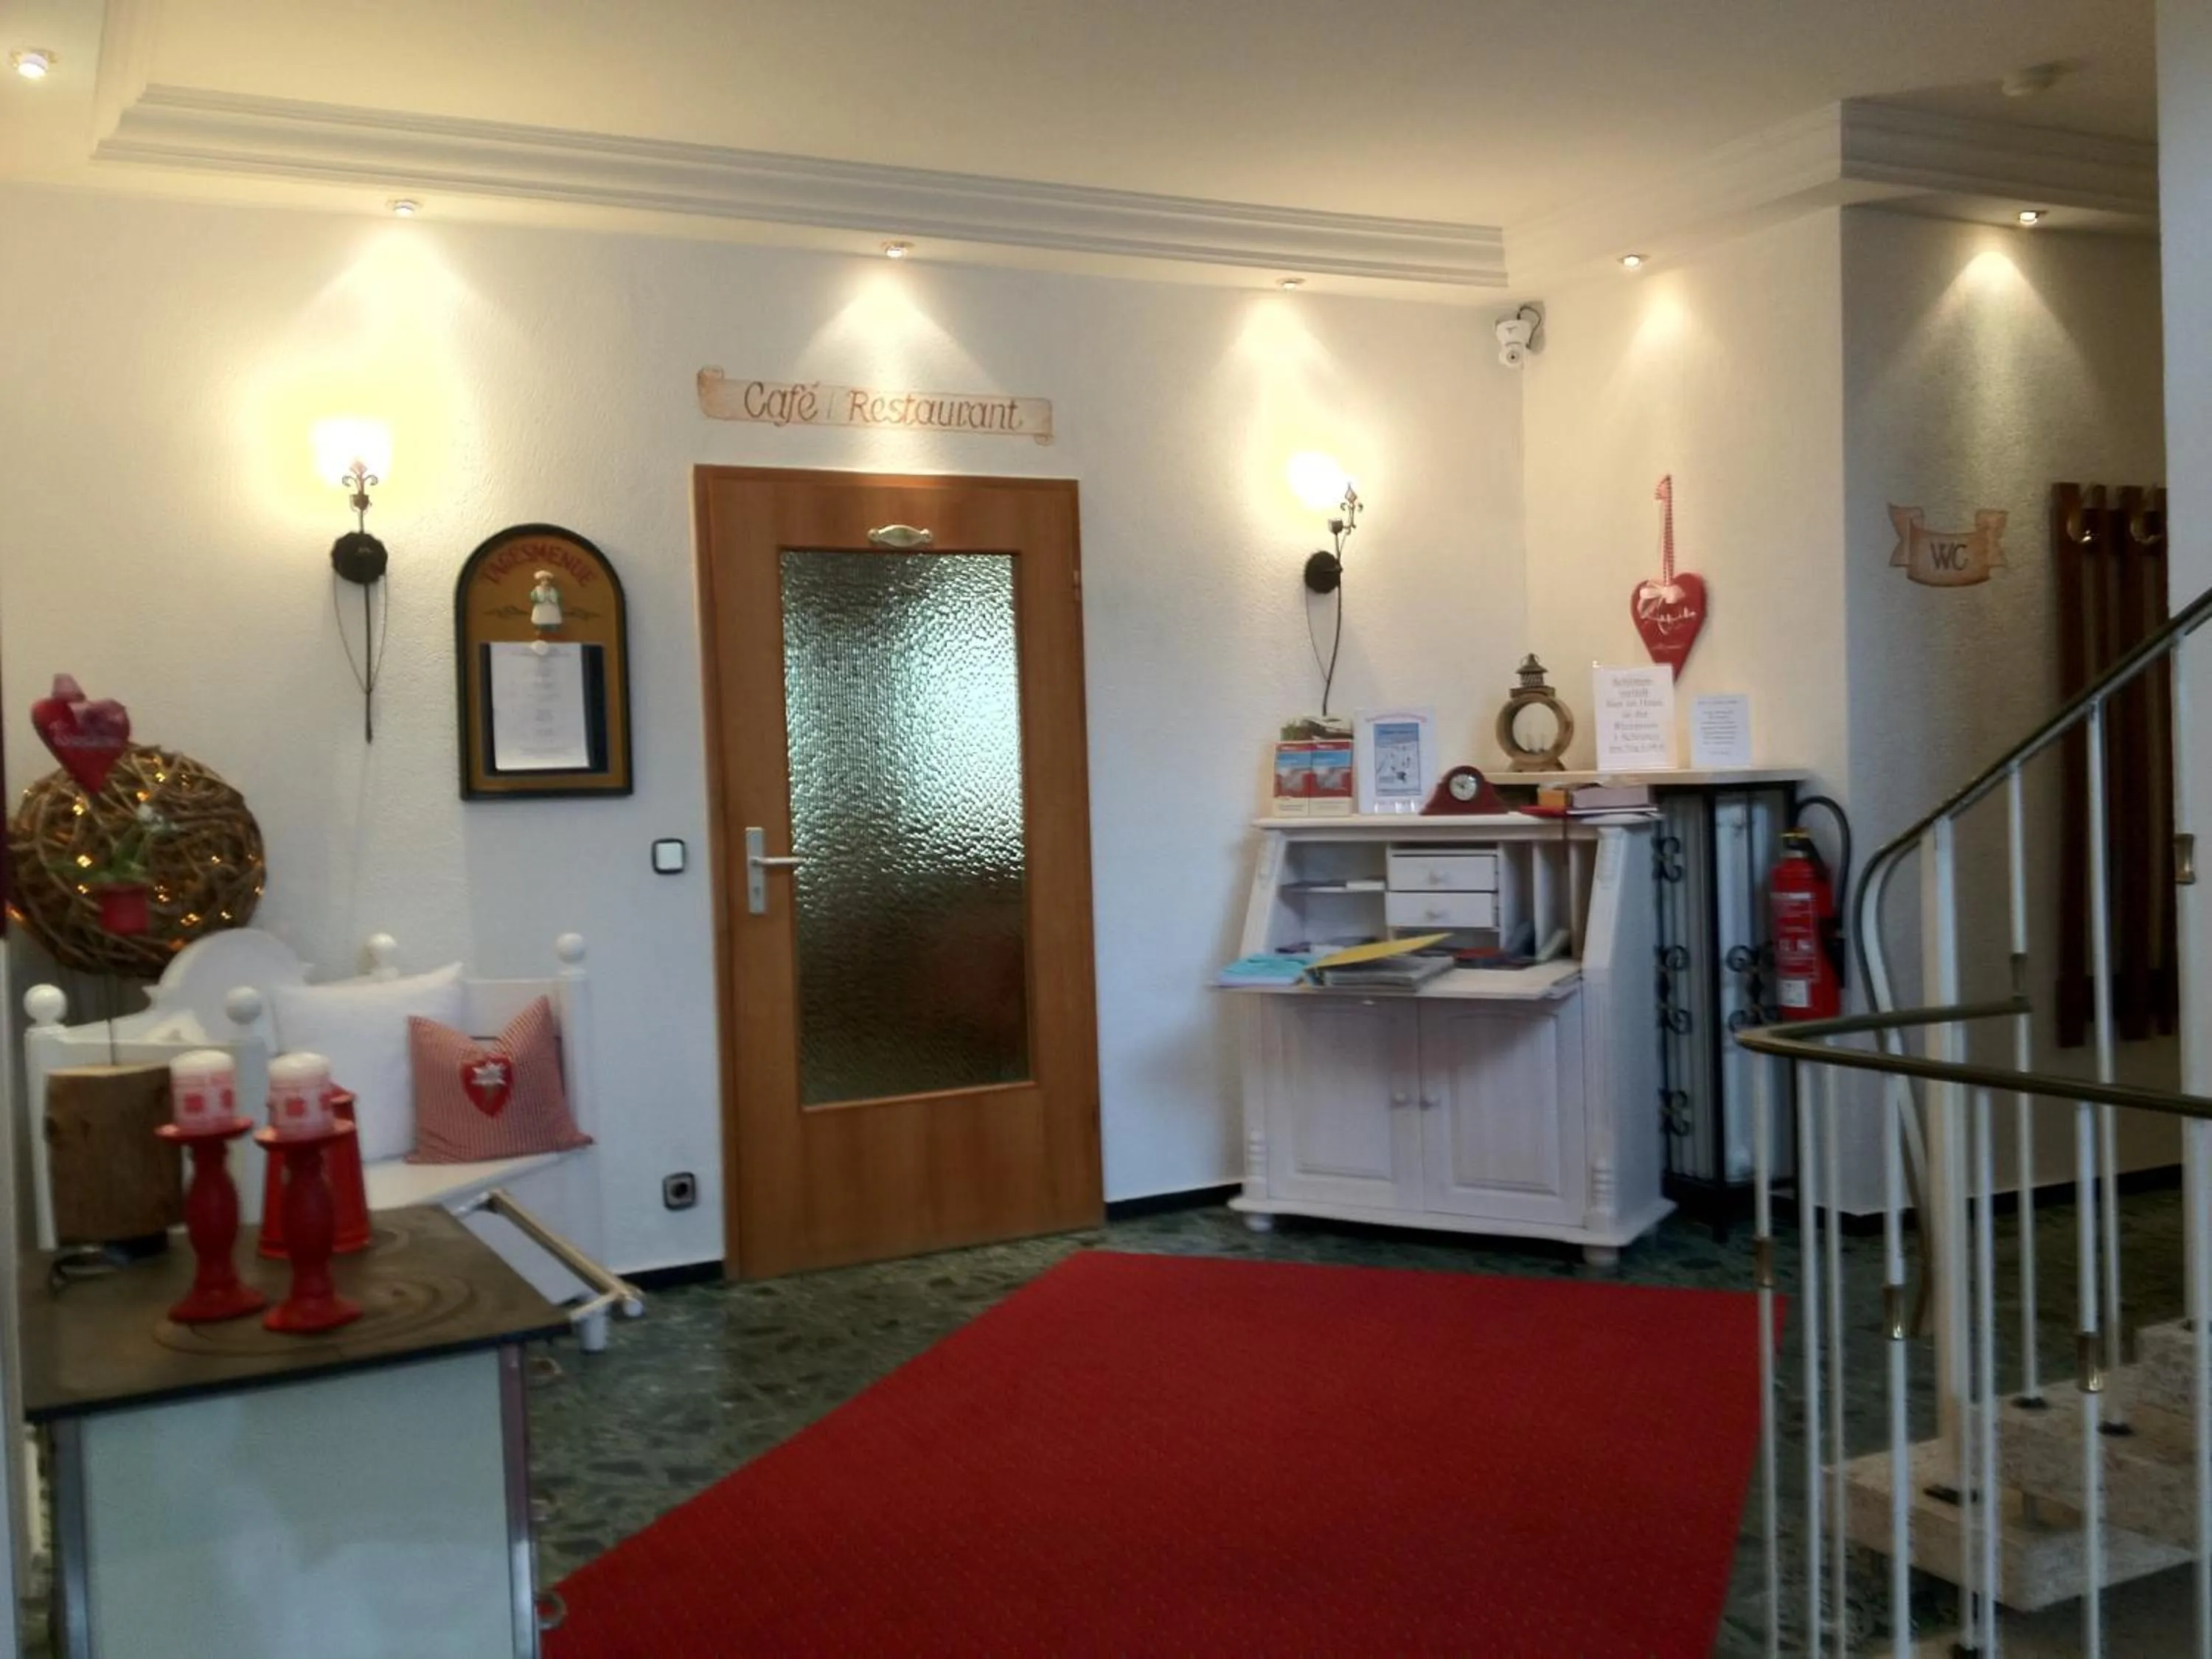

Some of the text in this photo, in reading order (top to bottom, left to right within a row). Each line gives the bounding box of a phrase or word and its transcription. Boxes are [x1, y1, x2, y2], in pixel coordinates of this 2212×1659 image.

[744, 380, 1023, 431] Café Restaurant
[1930, 543, 1969, 571] WC
